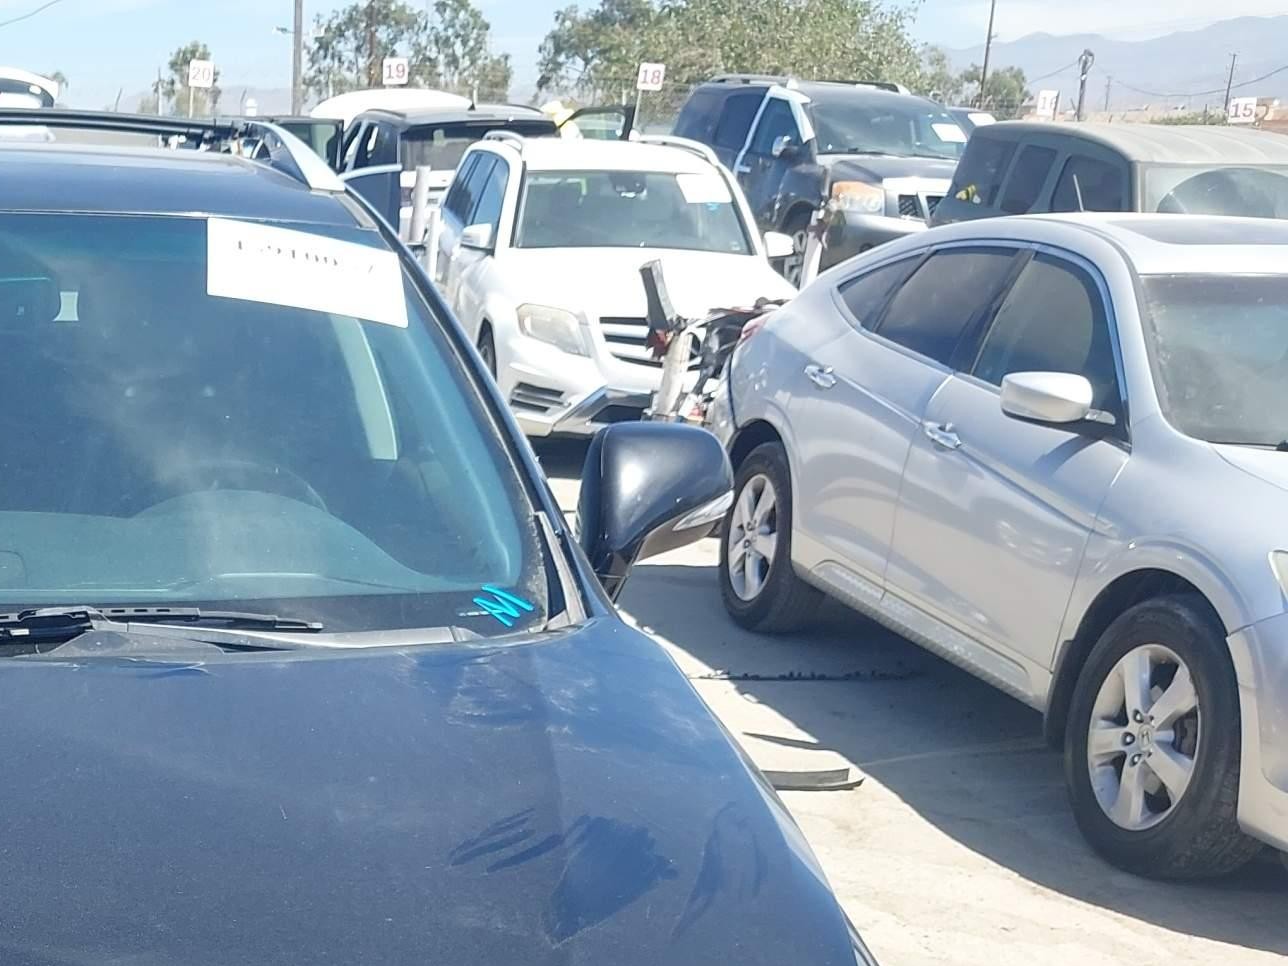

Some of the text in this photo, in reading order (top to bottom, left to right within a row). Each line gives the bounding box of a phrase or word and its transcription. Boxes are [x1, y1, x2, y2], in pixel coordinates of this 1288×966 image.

[192, 66, 211, 81] 20
[386, 63, 406, 80] 19
[640, 69, 662, 85] 18
[1230, 102, 1253, 118] 15
